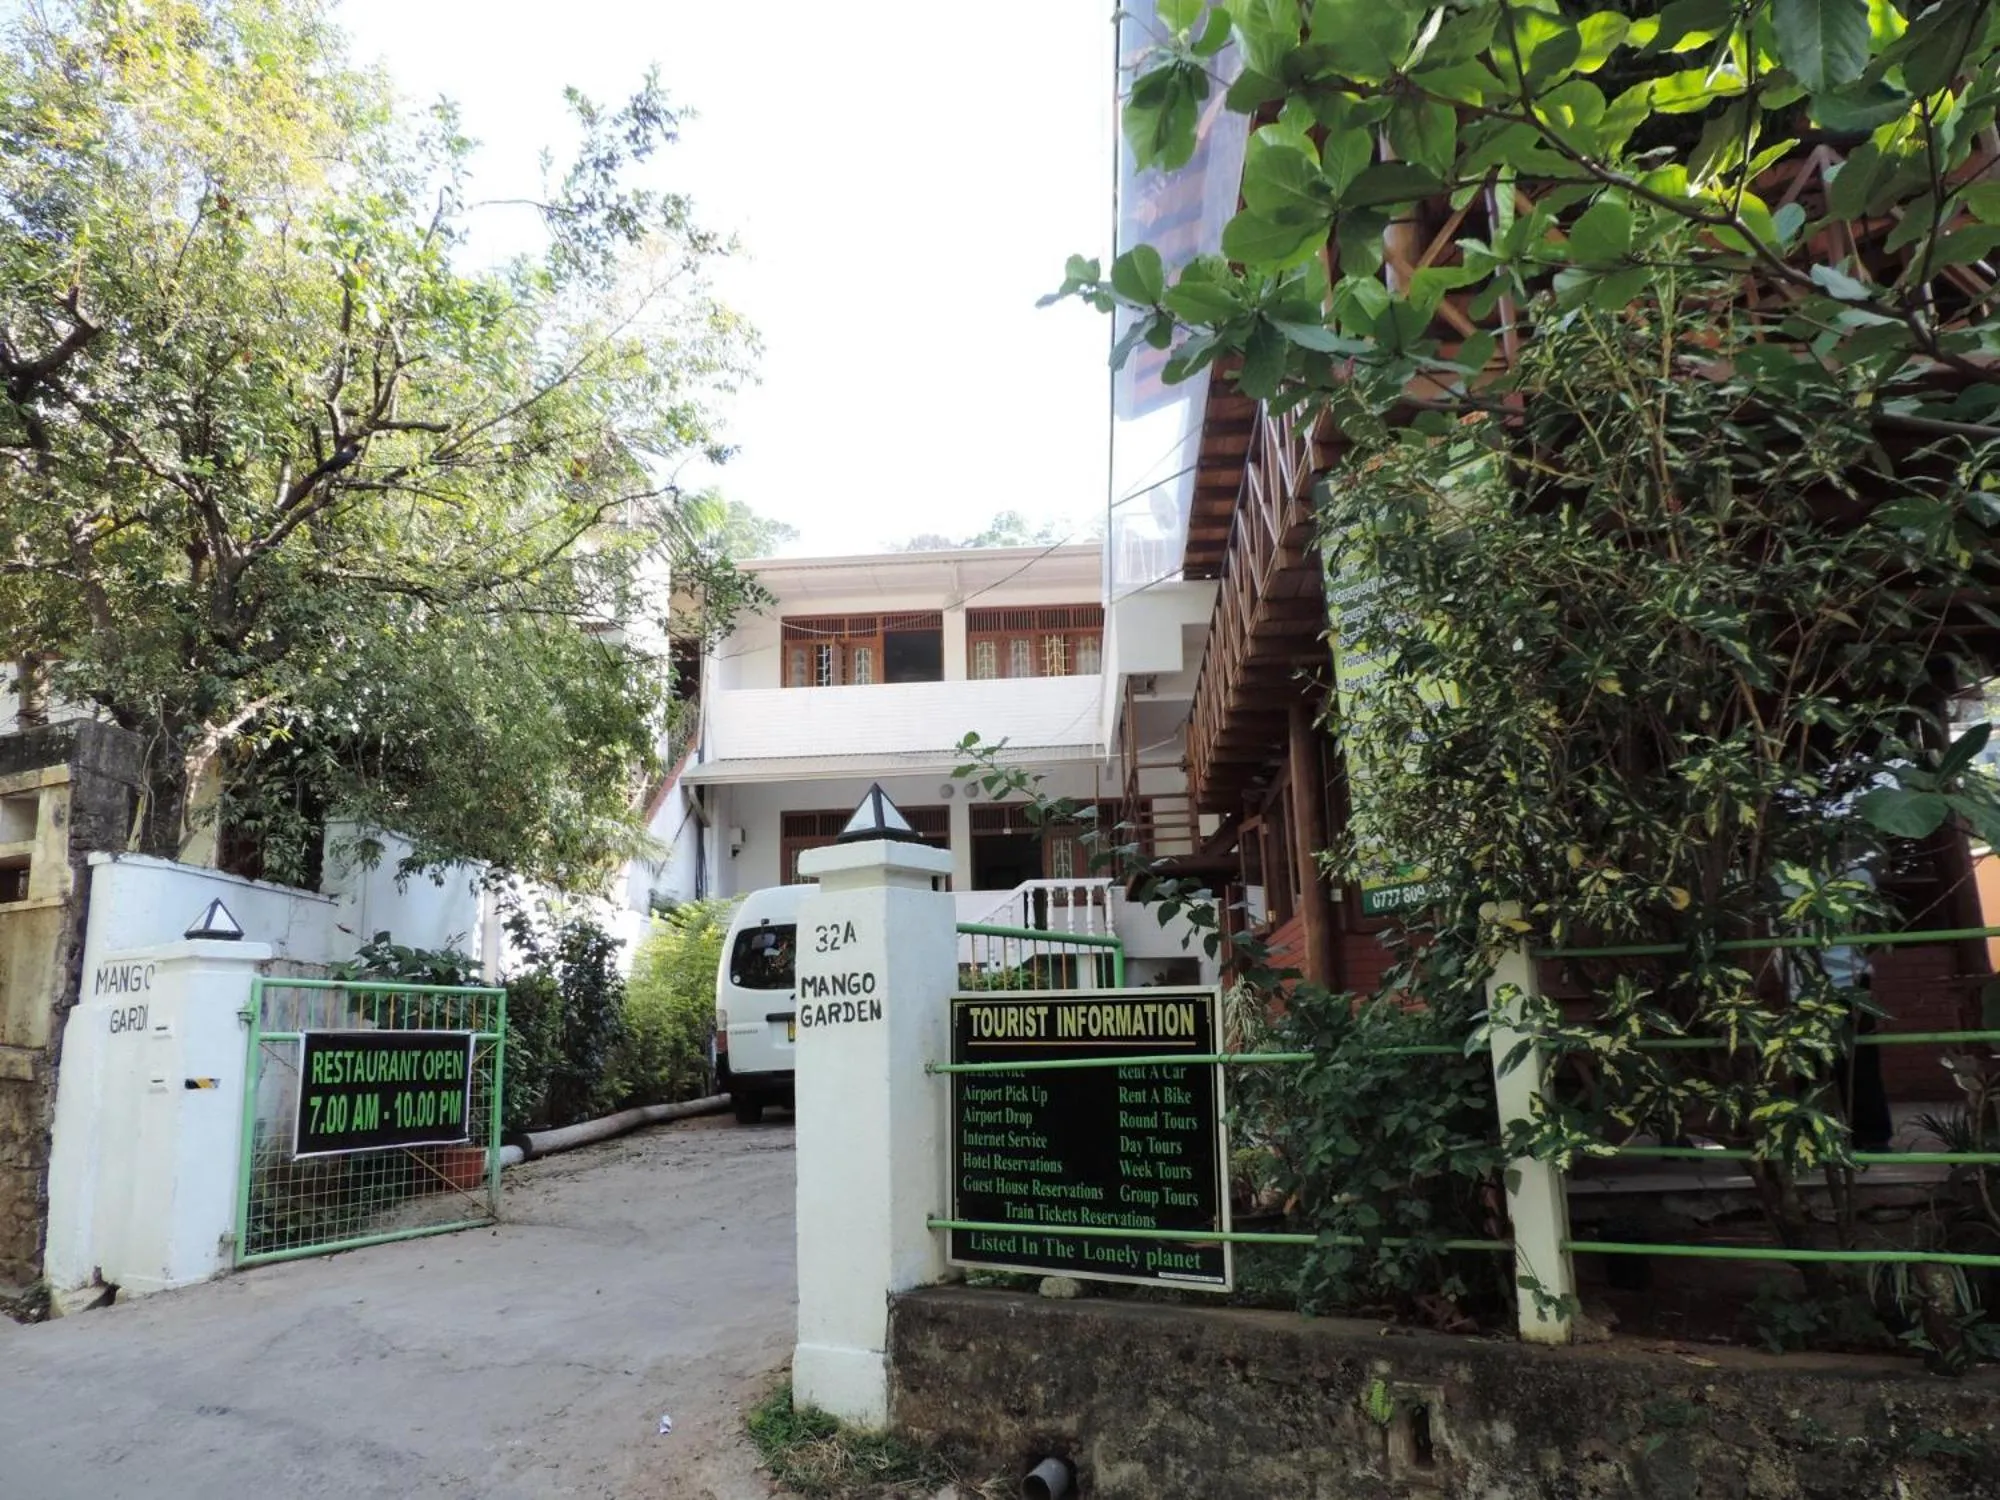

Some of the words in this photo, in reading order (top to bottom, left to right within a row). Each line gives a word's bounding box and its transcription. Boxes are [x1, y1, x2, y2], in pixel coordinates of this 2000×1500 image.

[816, 920, 857, 953] 32A
[95, 964, 155, 996] MANGO
[801, 972, 876, 999] MANGO
[110, 1003, 149, 1034] GARD
[801, 998, 882, 1028] GARDEN
[969, 1006, 1049, 1038] TOURIST
[1056, 1003, 1195, 1037] INFORMATION
[312, 1050, 421, 1084] RESTAURANT
[422, 1050, 464, 1081] OPEN
[1118, 1065, 1146, 1079] Rent
[1150, 1064, 1160, 1079] A
[1162, 1064, 1188, 1080] Car
[963, 1084, 1003, 1105] Airport
[1005, 1085, 1029, 1103] Pick
[1031, 1086, 1049, 1108] Up
[1118, 1086, 1147, 1104] Rent
[1150, 1087, 1161, 1104] A
[1163, 1086, 1193, 1105] Bike
[309, 1093, 349, 1135] 7.00
[351, 1092, 380, 1132] AM
[394, 1090, 436, 1129] 10.00
[439, 1089, 463, 1126] PM
[963, 1107, 1003, 1128] Airport
[1005, 1107, 1033, 1129] Drop
[1119, 1110, 1158, 1129] Round
[1162, 1111, 1198, 1130] Tours
[963, 1129, 1005, 1147] Internet
[1007, 1130, 1048, 1149] Service
[1119, 1135, 1142, 1158] Day
[1146, 1136, 1183, 1155] Tours
[963, 1151, 991, 1170] Hotel
[993, 1153, 1063, 1173] Reservations
[1119, 1159, 1153, 1178] Week
[1156, 1161, 1193, 1180] Tours
[963, 1175, 994, 1193] Guest
[996, 1177, 1029, 1196] House
[1031, 1178, 1104, 1200] Reservations
[1119, 1184, 1160, 1208] Group
[1162, 1187, 1199, 1207] Tours
[1004, 1201, 1035, 1220] Train
[1037, 1203, 1078, 1224] Tickets
[1080, 1206, 1157, 1229] Reservations
[970, 1232, 1017, 1253] Listed
[1021, 1236, 1039, 1255] In
[1043, 1238, 1075, 1258] The
[1083, 1241, 1140, 1268] Lonely
[1145, 1247, 1201, 1271] planet
